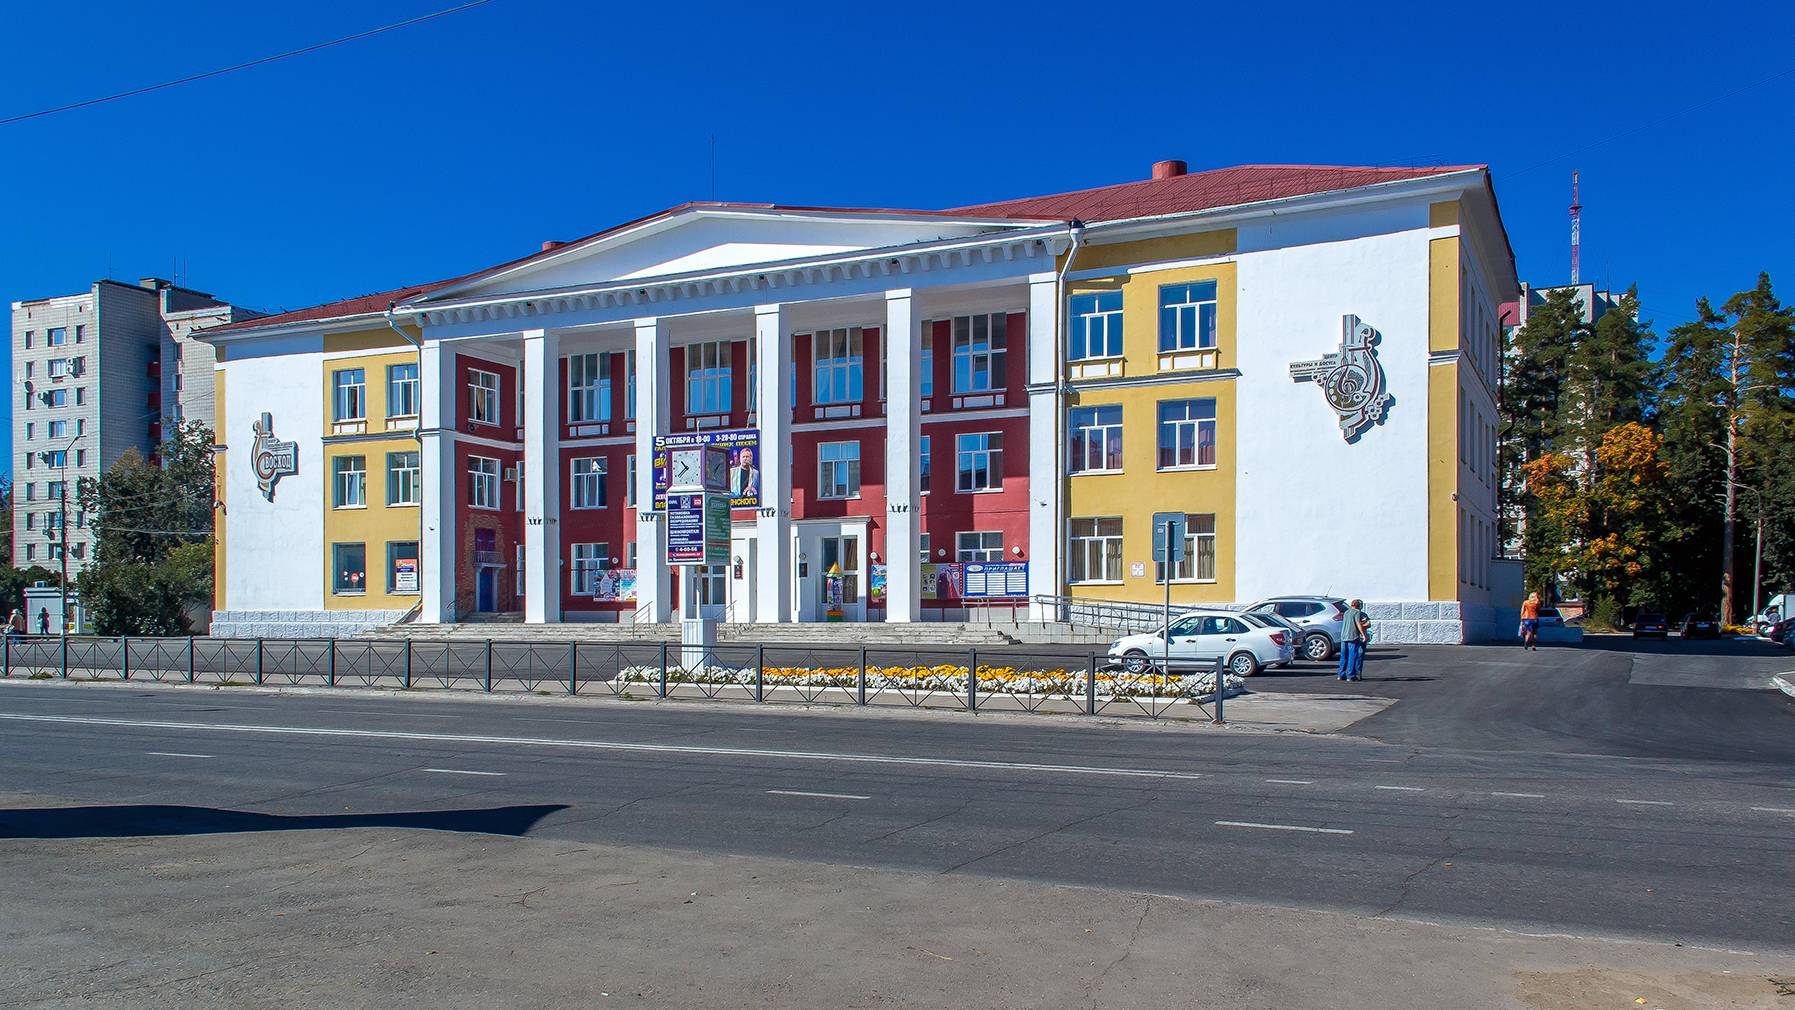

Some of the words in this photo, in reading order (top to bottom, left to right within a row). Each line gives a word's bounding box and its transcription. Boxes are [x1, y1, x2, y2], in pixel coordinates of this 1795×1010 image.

[655, 436, 665, 446] 5
[665, 436, 691, 445] ОКТЯБРЯ
[265, 455, 291, 469] ВОСХОД
